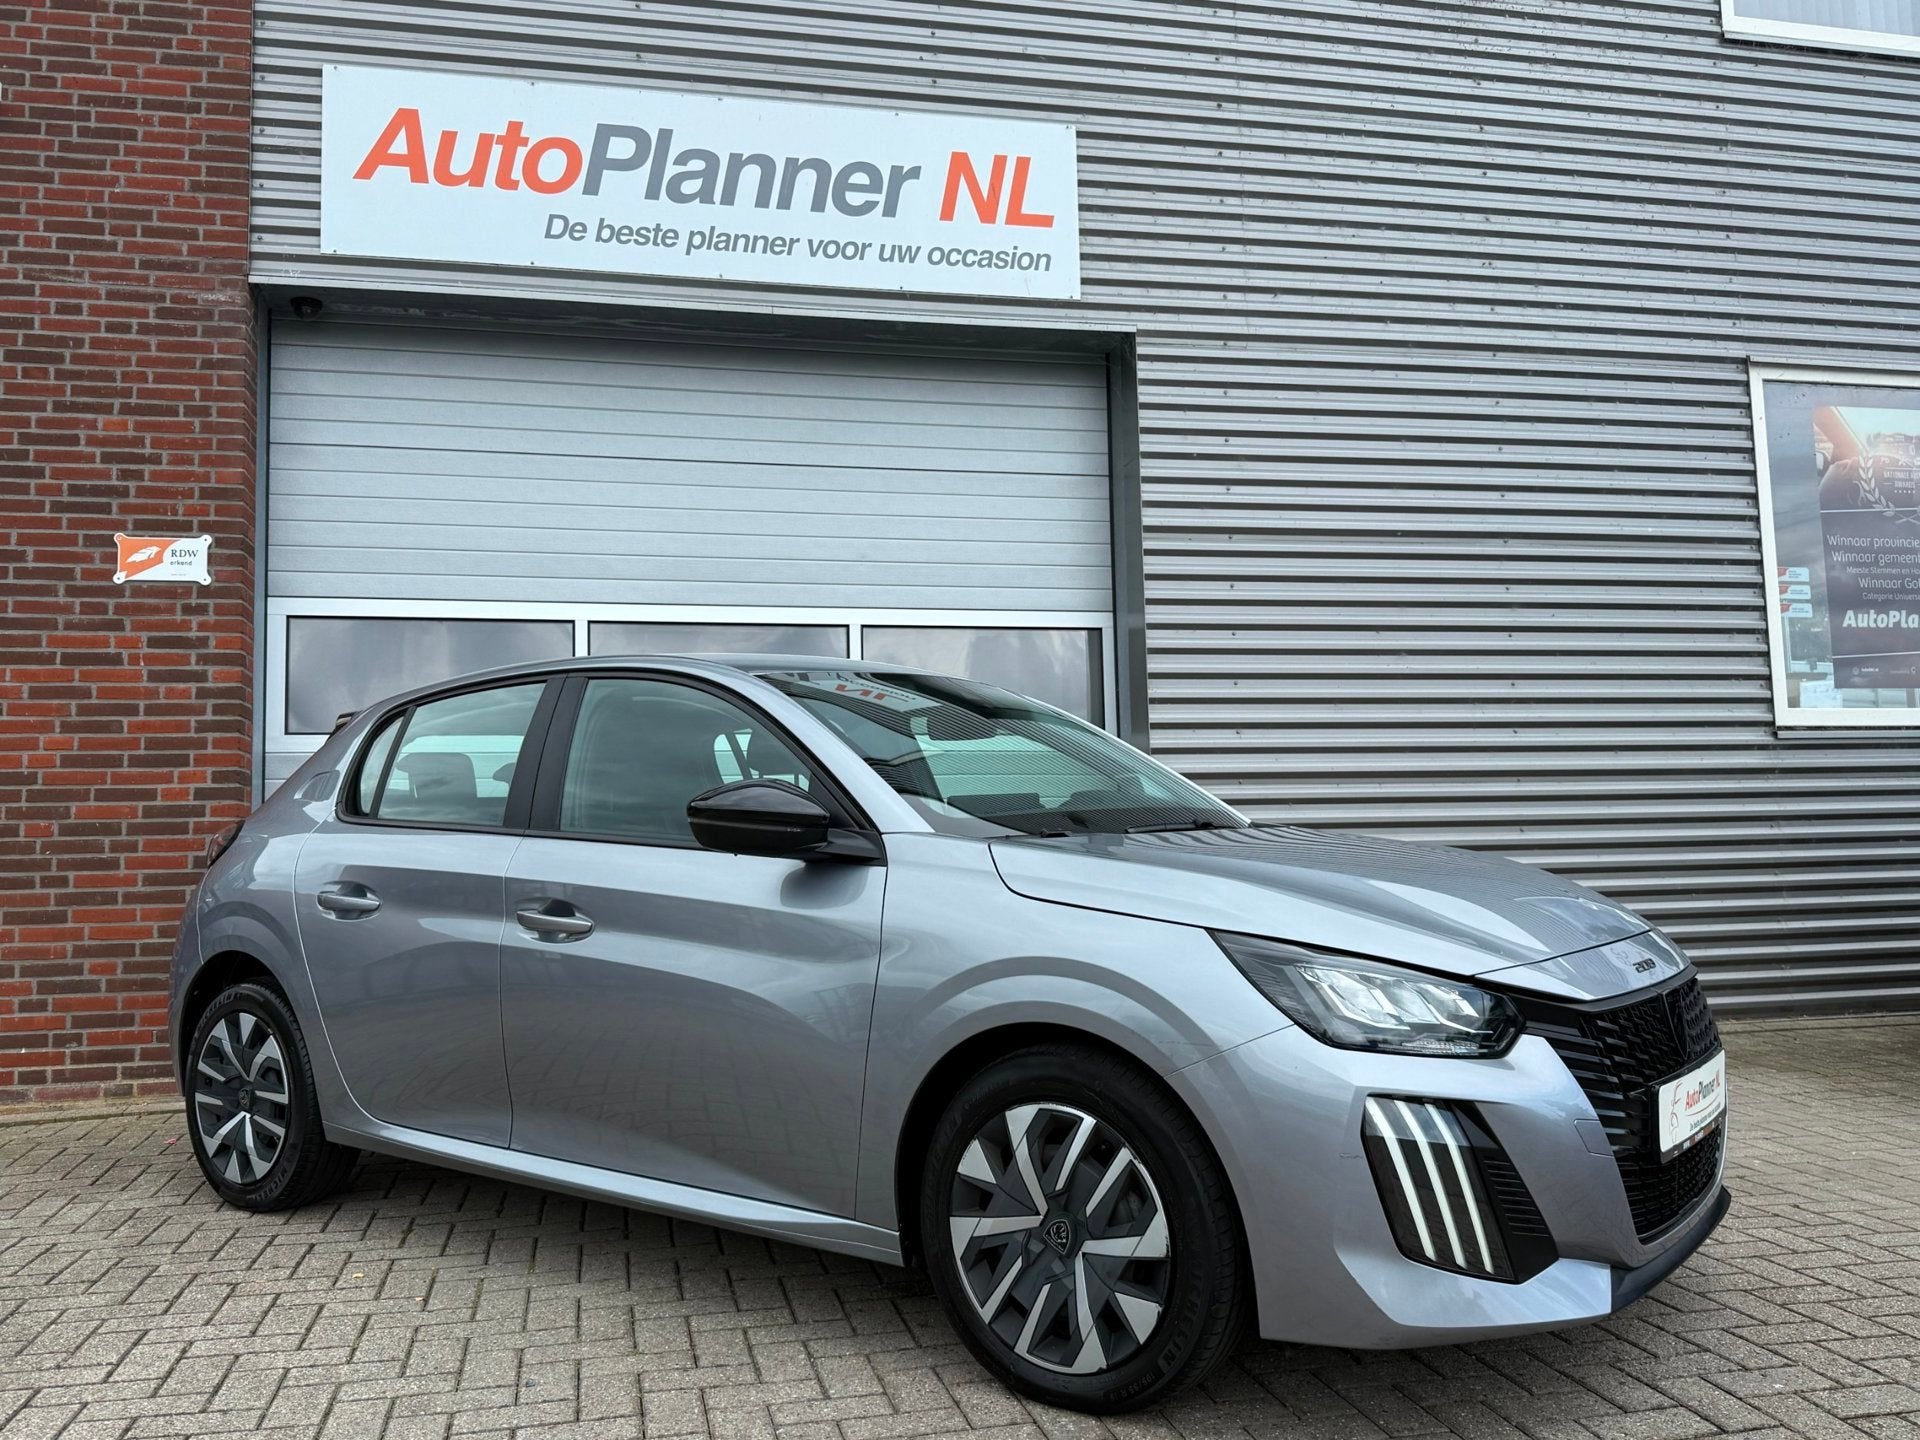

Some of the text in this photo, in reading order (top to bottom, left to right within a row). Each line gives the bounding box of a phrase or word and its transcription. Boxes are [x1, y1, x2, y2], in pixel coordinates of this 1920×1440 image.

[352, 107, 1055, 228] AutoPlanner NL
[544, 213, 1052, 272] De beste planner voor uw occasion
[1826, 534, 1871, 547] Winnaar
[171, 549, 199, 558] RDW
[1832, 550, 1876, 562] Winnaar
[1857, 576, 1902, 589] Winnaar
[1841, 609, 1920, 629] AutoPla
[1632, 958, 1657, 974] 208
